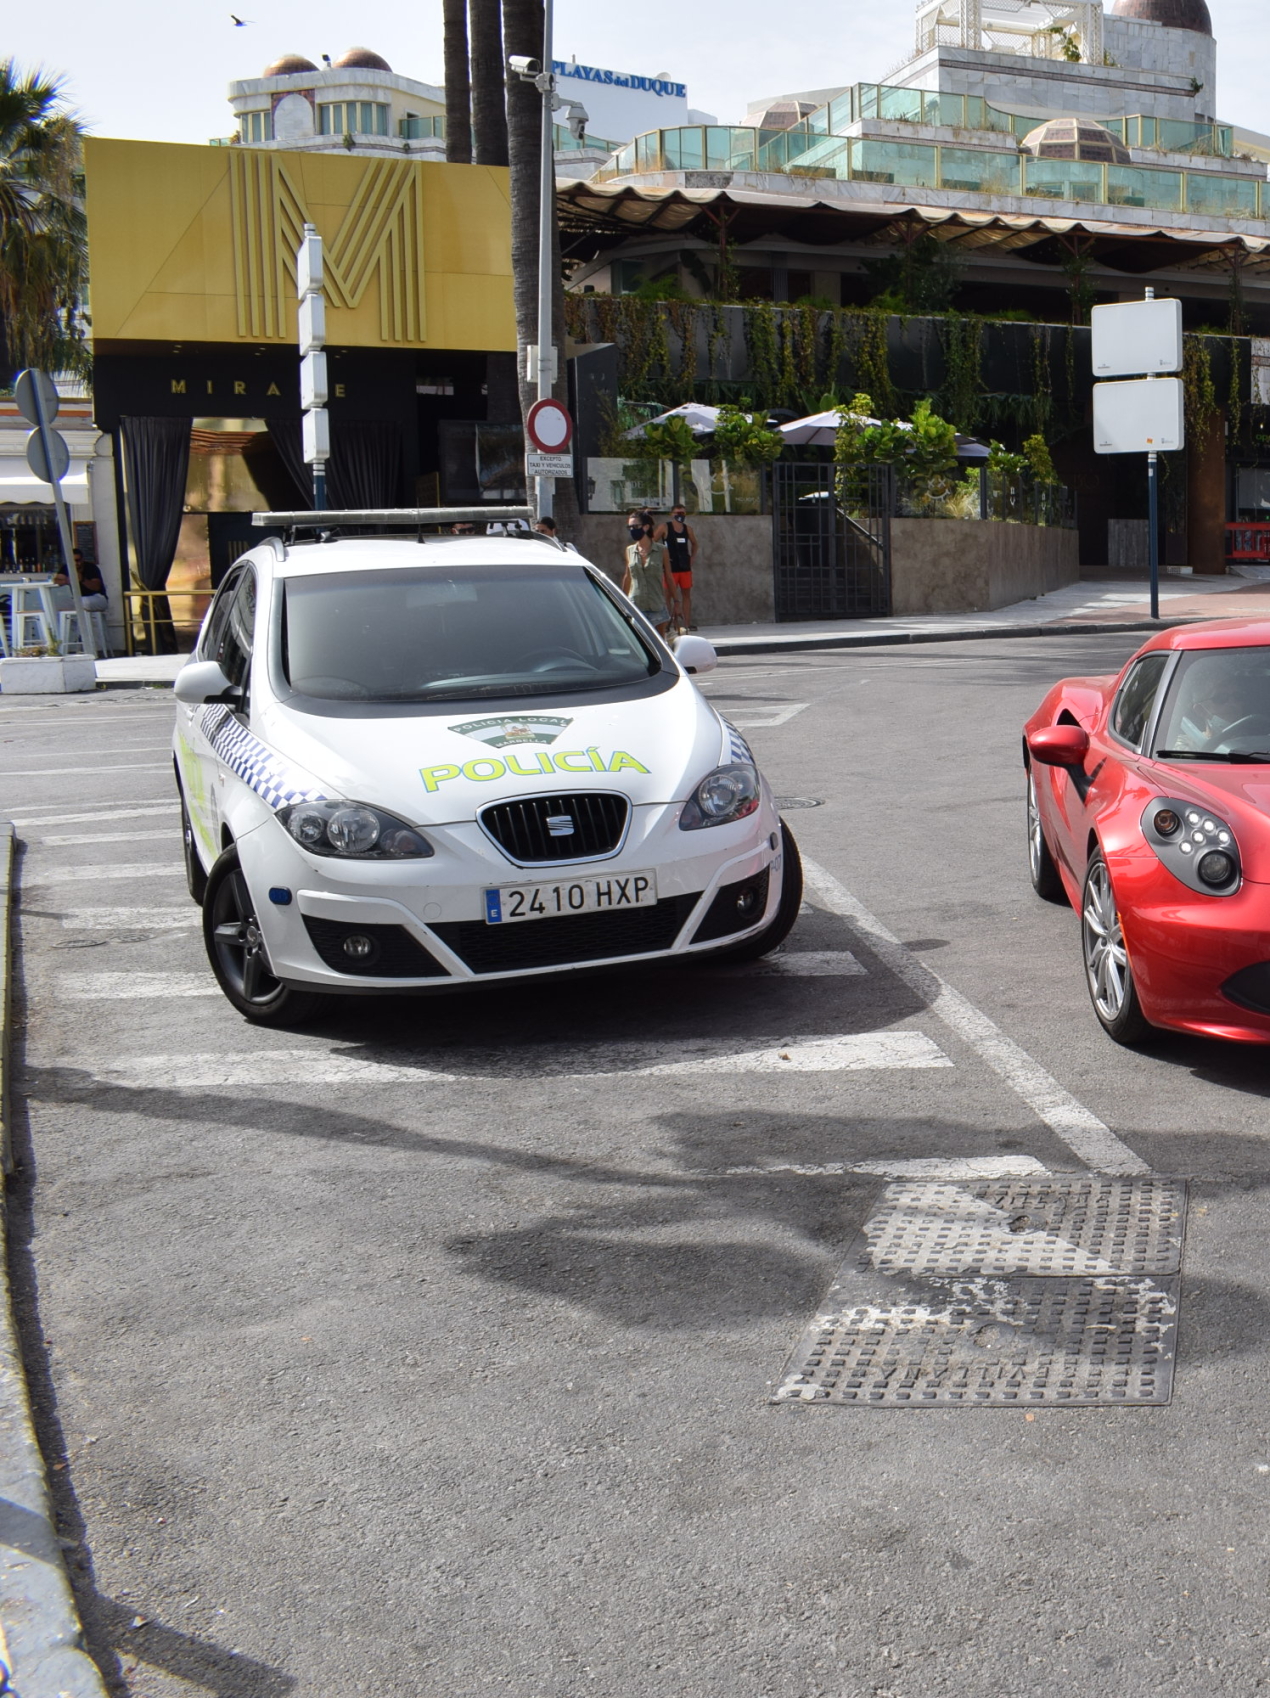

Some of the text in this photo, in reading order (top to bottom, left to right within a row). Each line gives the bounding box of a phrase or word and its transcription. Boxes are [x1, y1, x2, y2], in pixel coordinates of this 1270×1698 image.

[551, 60, 613, 85] PLAYAS
[629, 74, 686, 98] DUQUE
[171, 379, 346, 398] MIRAE
[518, 717, 568, 727] LOCAL
[419, 745, 652, 793] POLICÍA
[508, 876, 649, 918] 2410 HXP
